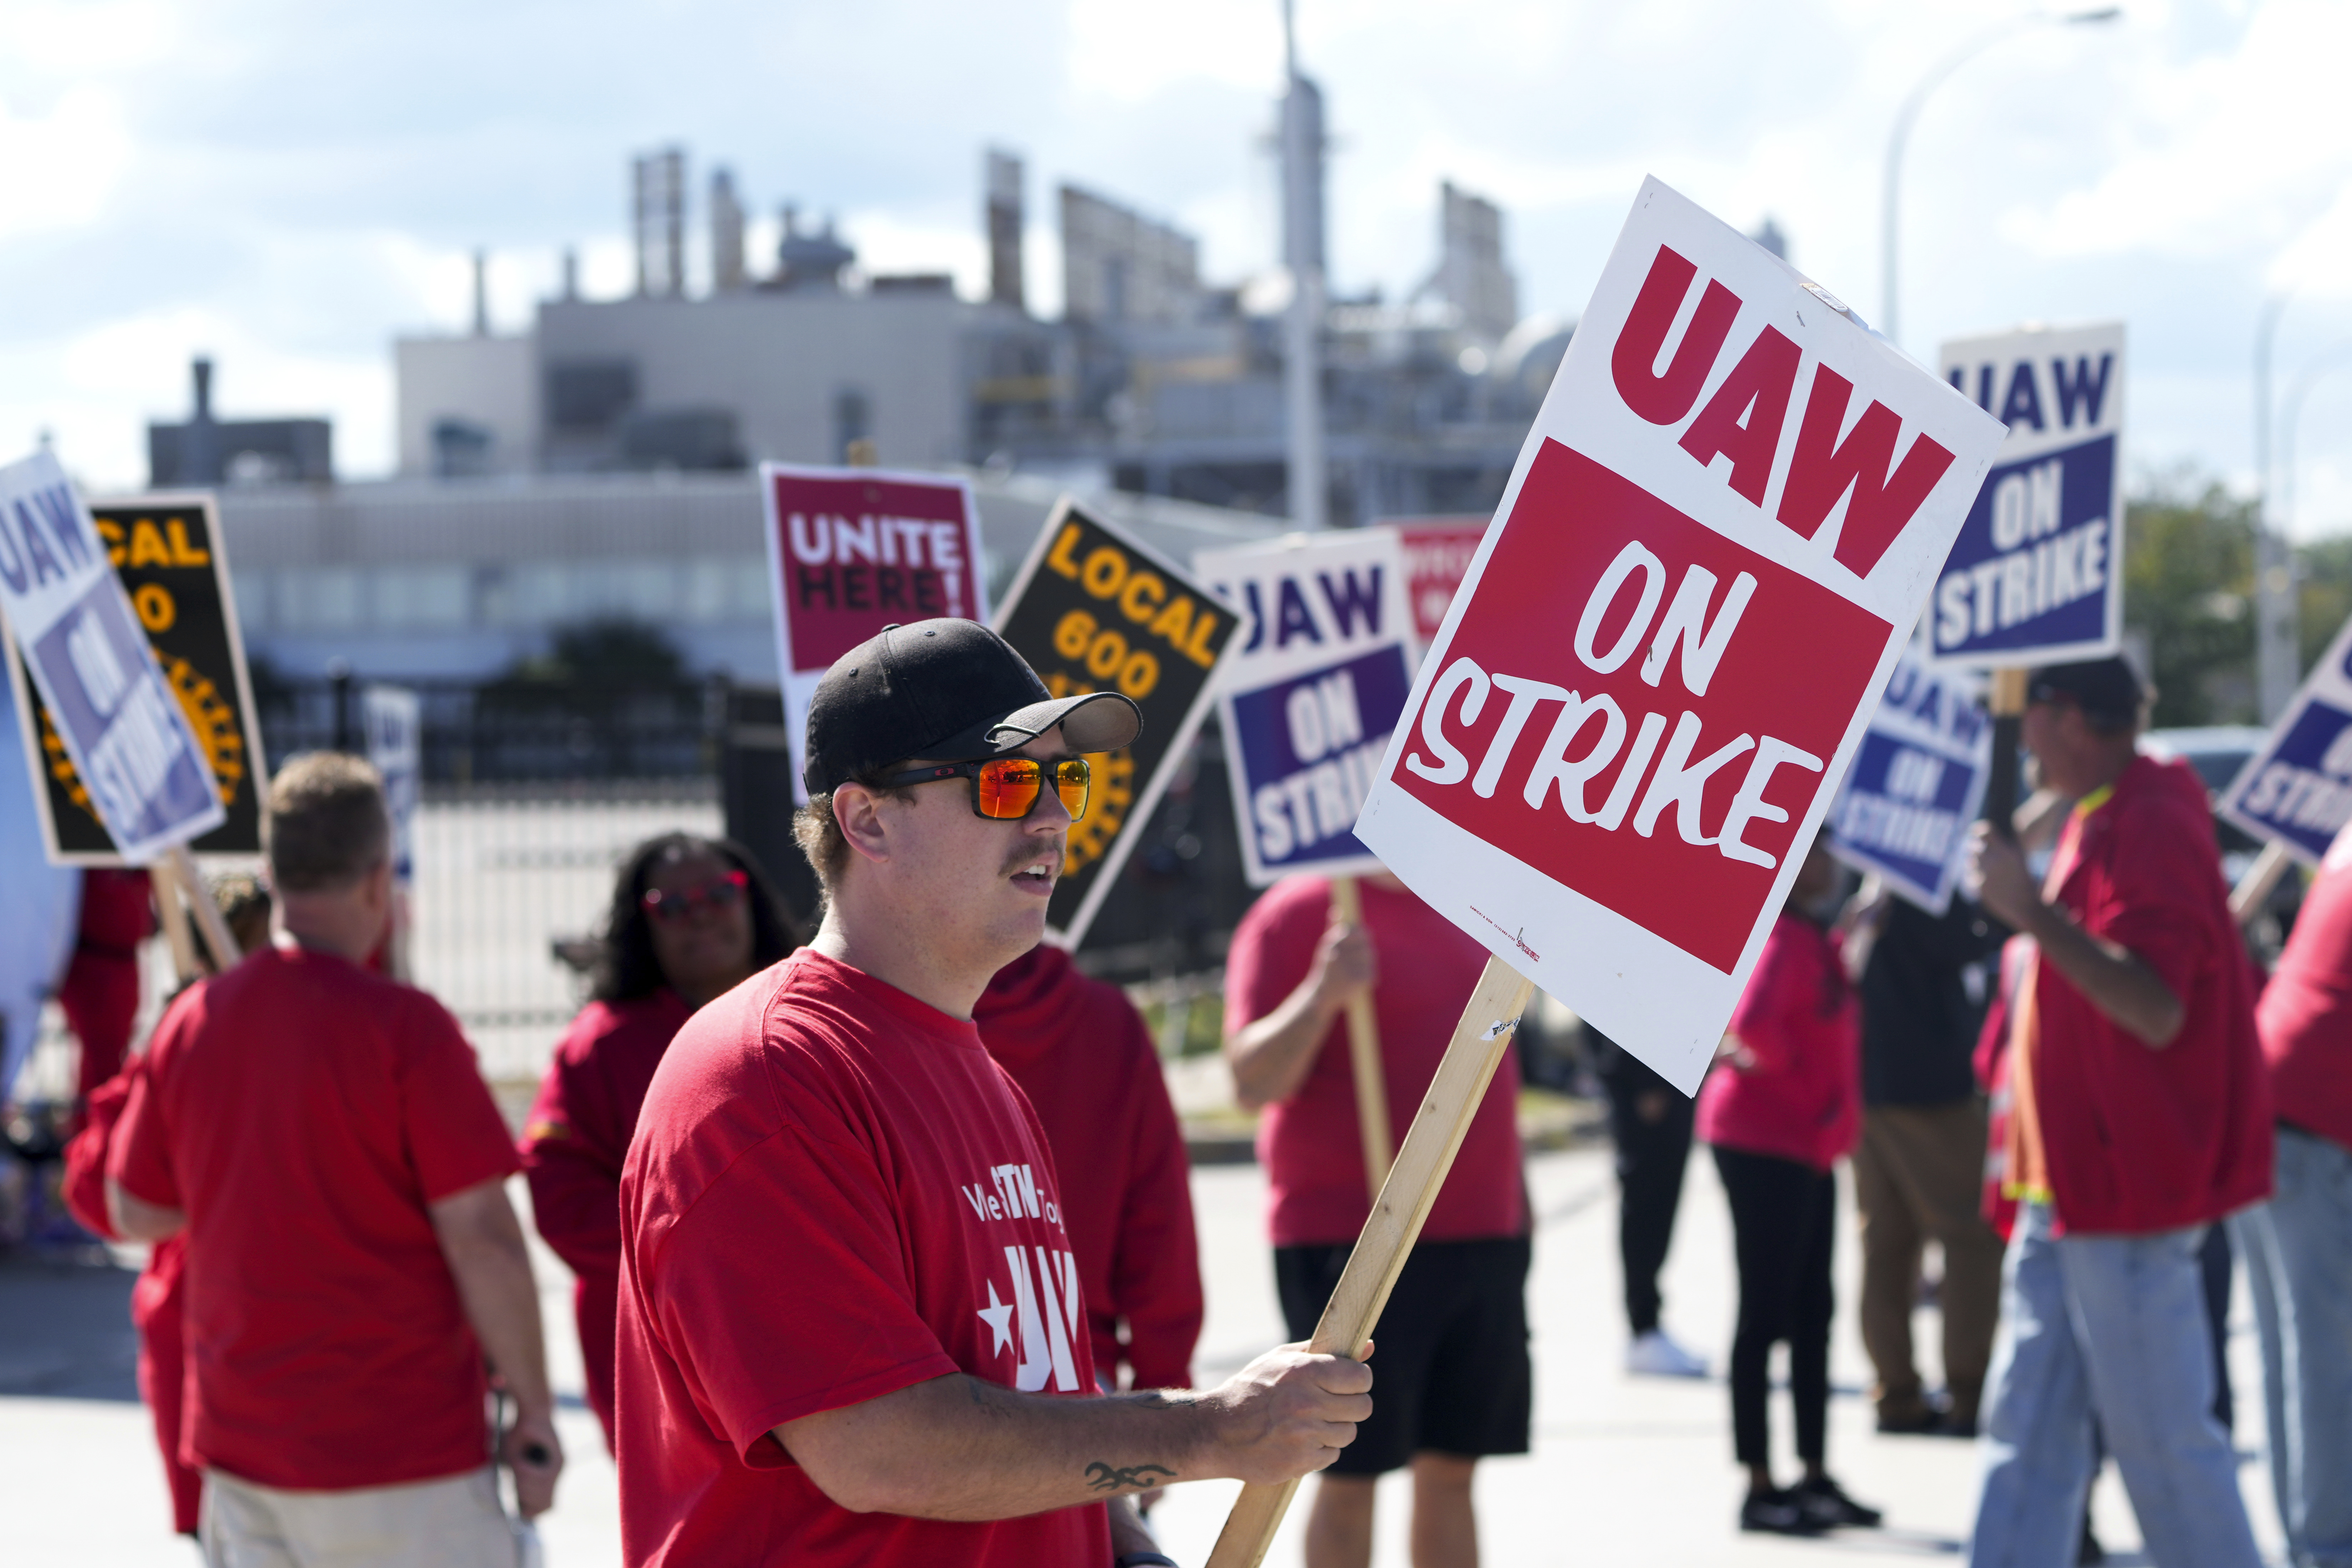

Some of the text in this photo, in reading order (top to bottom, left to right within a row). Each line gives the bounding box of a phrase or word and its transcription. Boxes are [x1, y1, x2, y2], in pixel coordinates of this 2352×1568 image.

[1612, 243, 1956, 580] UAW
[93, 516, 211, 569] CAL
[788, 512, 963, 570] UNITE
[1990, 458, 2065, 552] ON
[1047, 522, 1221, 669] LOCAL
[1573, 540, 1758, 697] ON
[1935, 515, 2109, 649] STRIKE
[1052, 609, 1160, 700] 600
[1286, 669, 1364, 765] ON
[1406, 657, 1823, 869] STRIKE
[1255, 729, 1394, 860] STRI
[1470, 905, 1483, 917] SAWICKI
